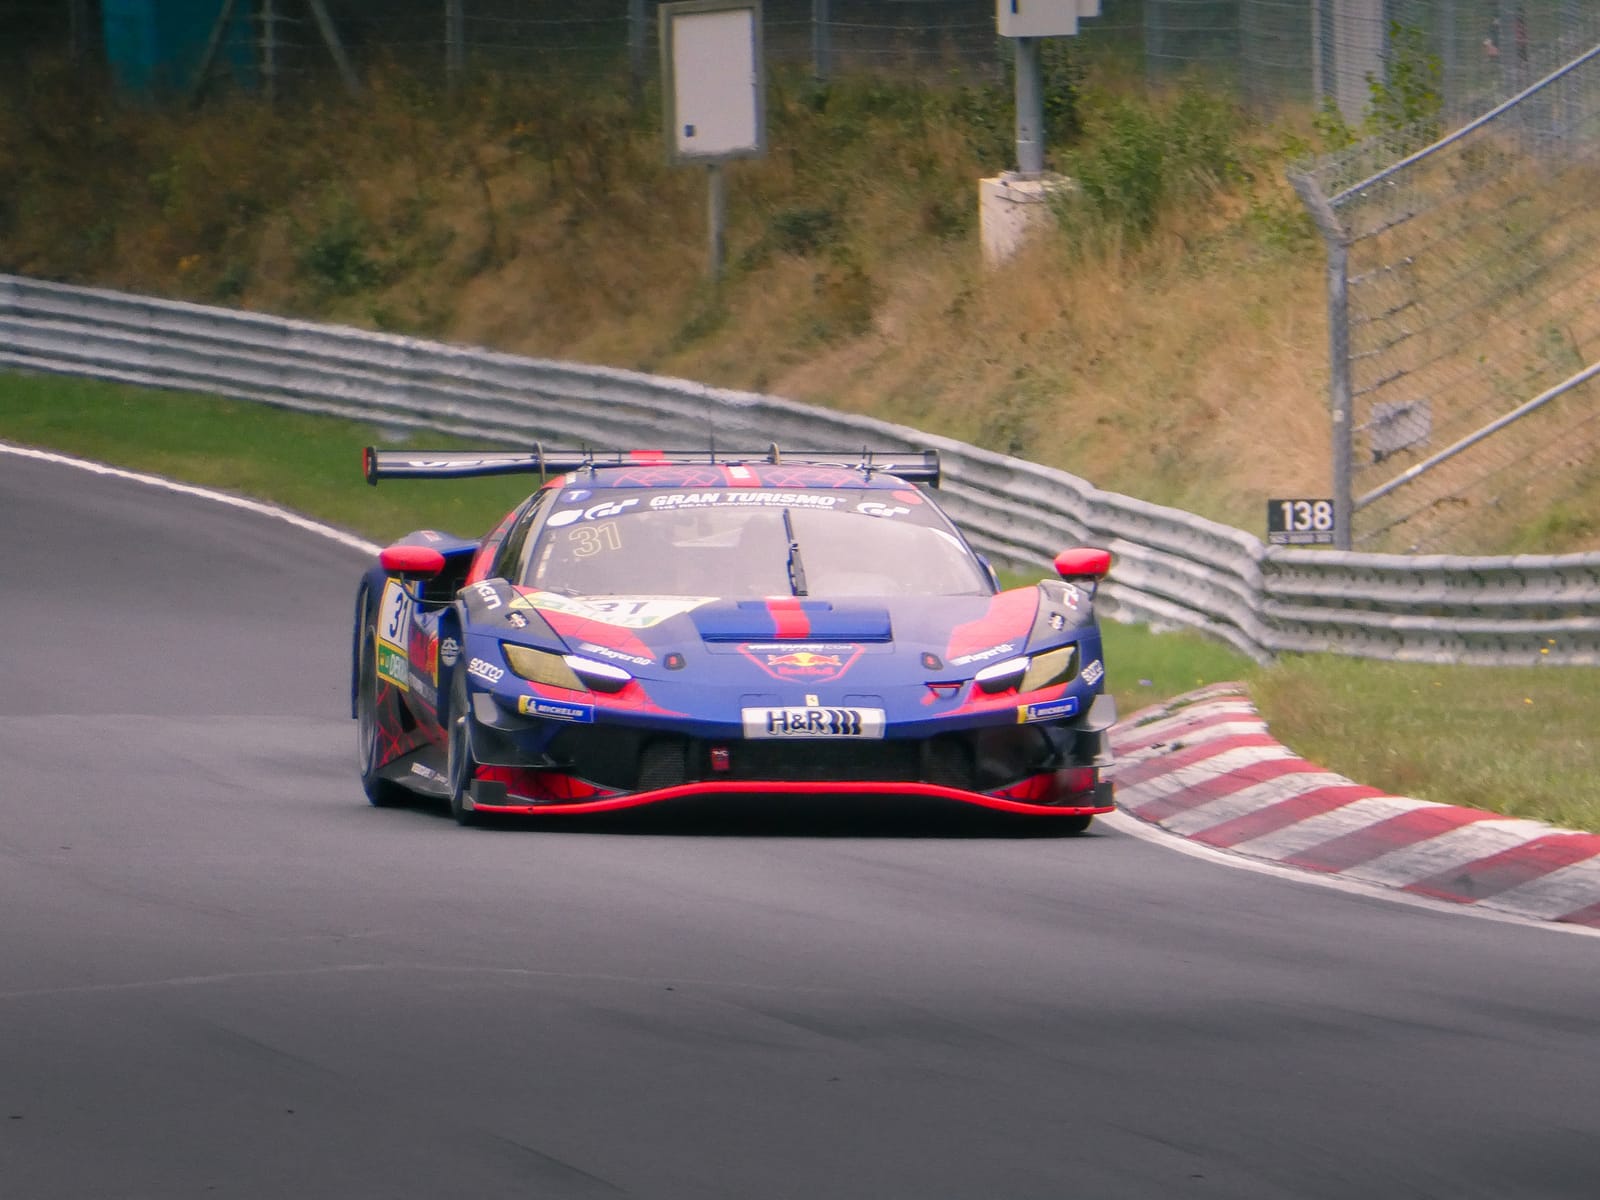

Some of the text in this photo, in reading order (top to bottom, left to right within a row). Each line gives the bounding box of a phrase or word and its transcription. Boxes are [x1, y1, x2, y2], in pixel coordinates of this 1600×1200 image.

[649, 492, 836, 507] GRAN TURISMO
[1281, 501, 1332, 530] 138
[568, 521, 622, 557] 31
[389, 592, 408, 642] 31
[467, 658, 504, 681] sparco
[767, 710, 827, 734] H&R
